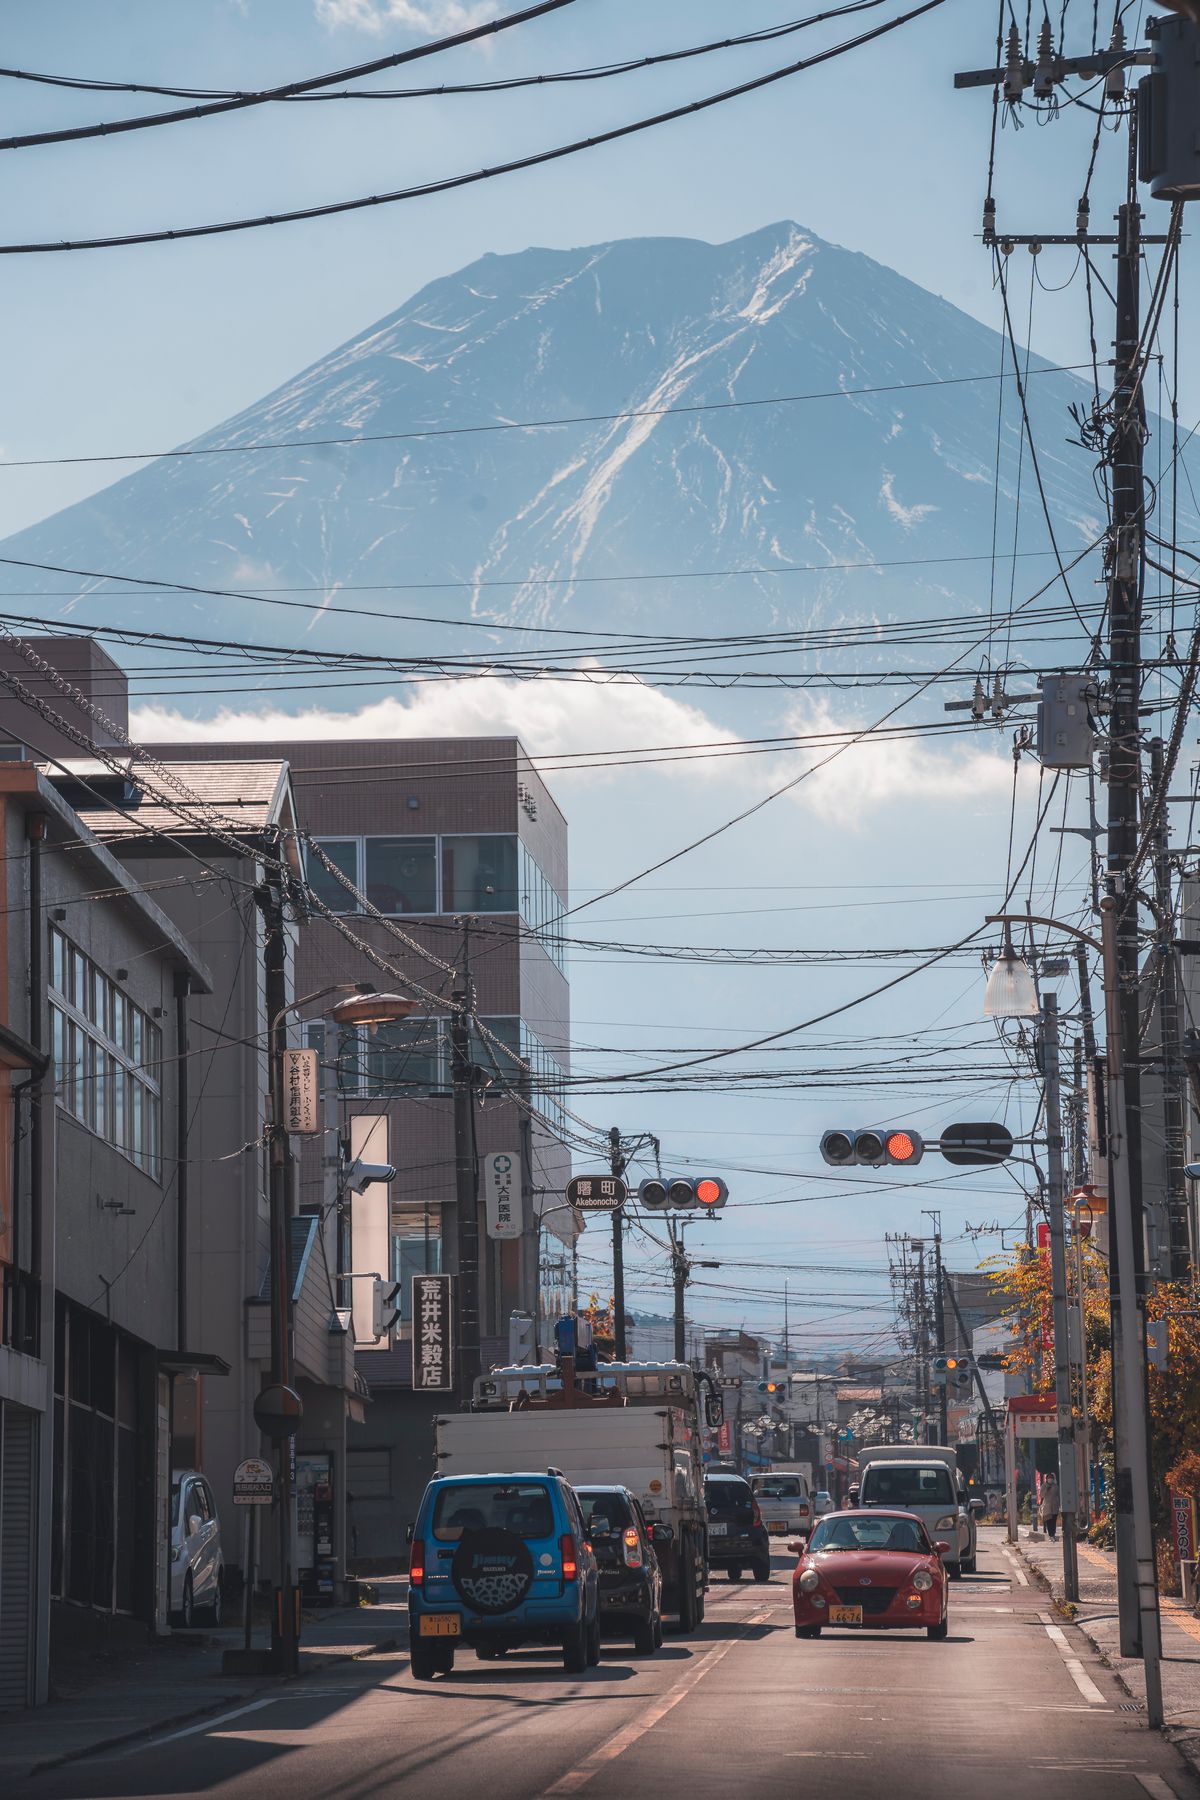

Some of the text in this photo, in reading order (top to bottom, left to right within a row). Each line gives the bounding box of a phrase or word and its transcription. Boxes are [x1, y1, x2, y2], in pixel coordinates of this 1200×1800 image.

[289, 1066, 301, 1128] 谷村信用組合
[497, 1186, 511, 1222] 大戸医院
[576, 1197, 618, 1206] Akebonocho
[577, 1181, 616, 1196] 曙町
[421, 1280, 442, 1386] 荒井米穀店
